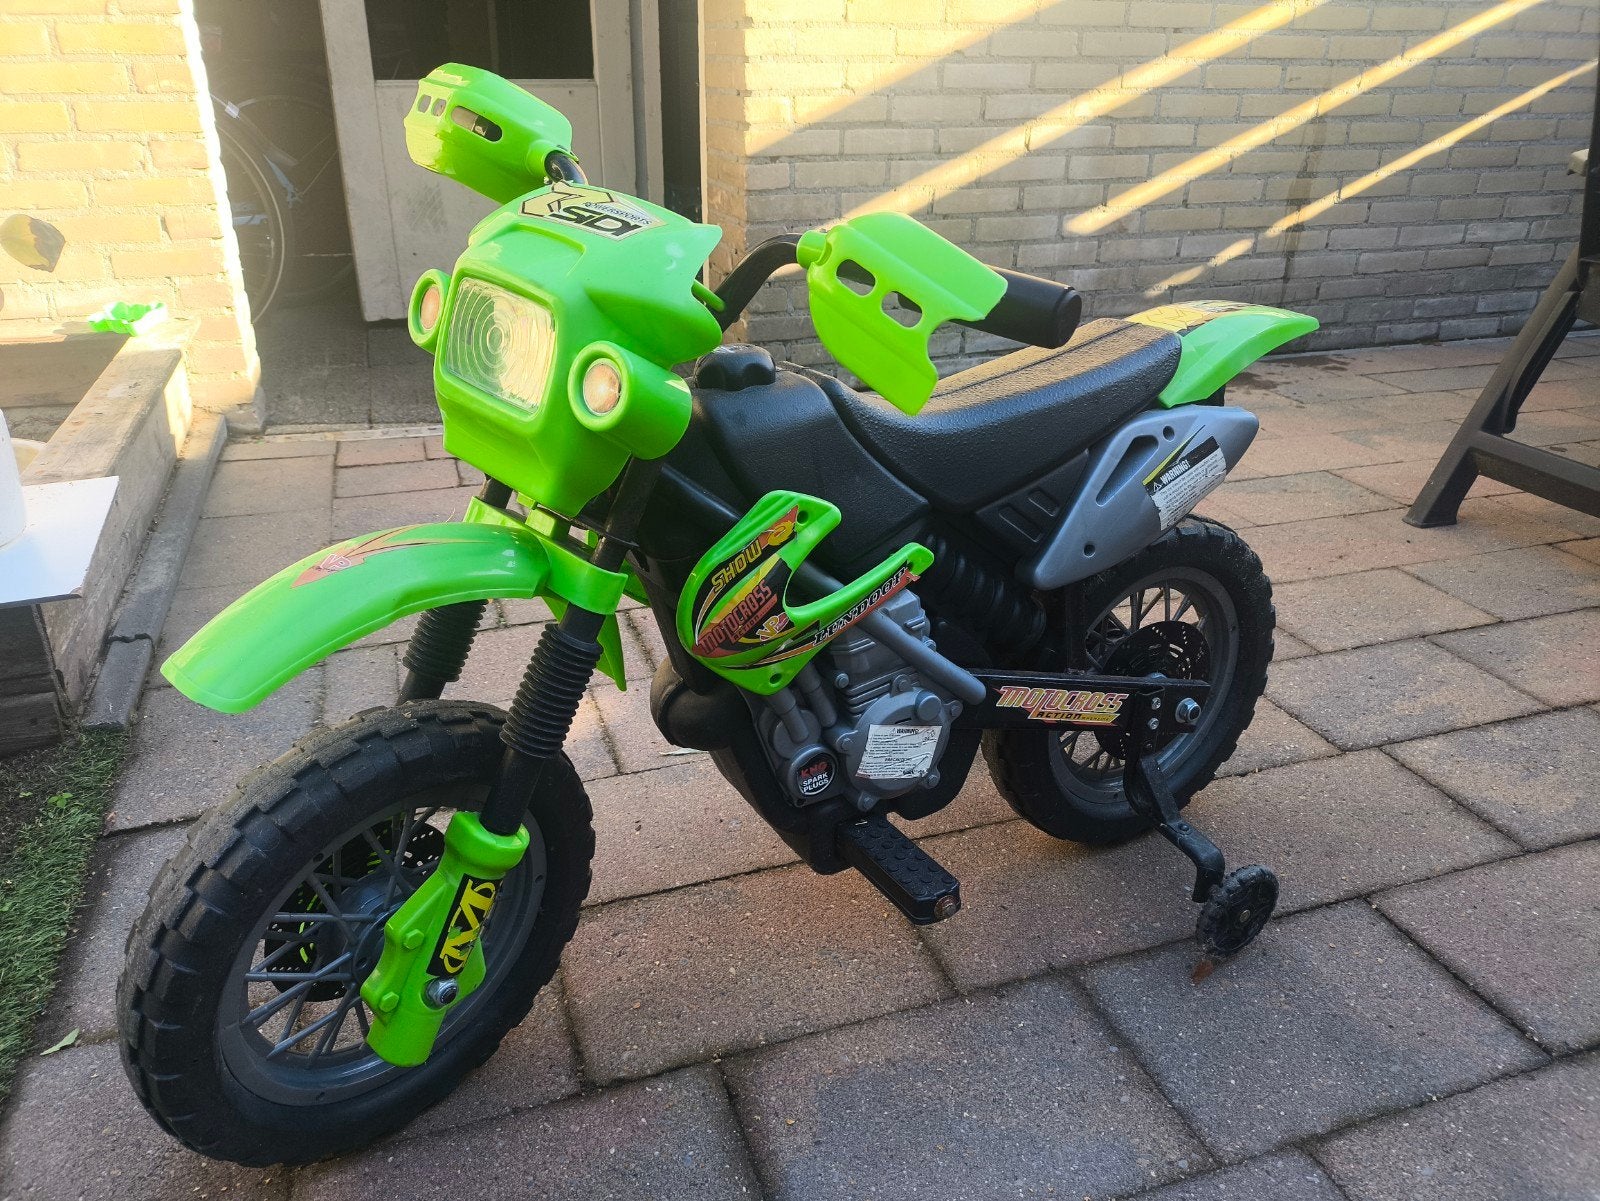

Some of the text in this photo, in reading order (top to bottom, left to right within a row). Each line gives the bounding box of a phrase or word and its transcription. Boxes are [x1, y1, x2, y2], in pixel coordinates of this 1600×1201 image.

[711, 540, 762, 593] SHOW
[699, 579, 773, 656] MOTOCROSS
[996, 686, 1129, 713] MOTOCROSS
[1037, 711, 1082, 720] ACTION
[802, 771, 829, 787] SPARK
[803, 778, 829, 792] PLUGS
